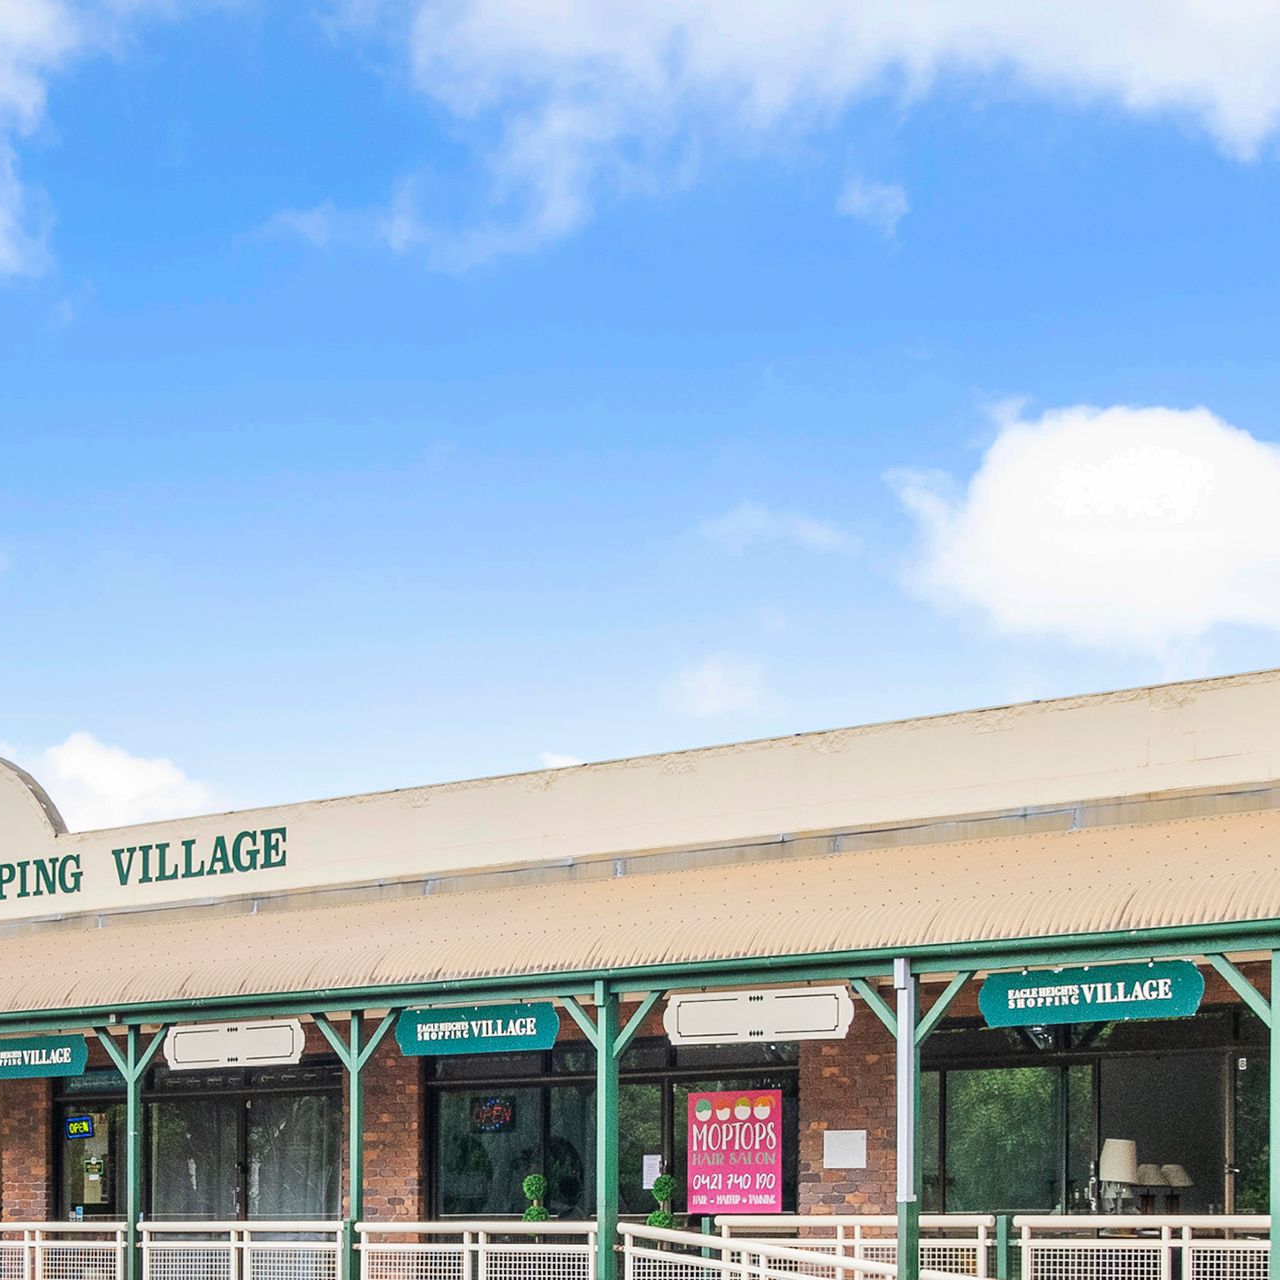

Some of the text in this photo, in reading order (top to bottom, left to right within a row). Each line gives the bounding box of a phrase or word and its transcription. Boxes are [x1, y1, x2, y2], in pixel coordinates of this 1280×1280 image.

[112, 826, 287, 886] VILLAGE
[1008, 985, 1080, 1000] EAGLE HEIGHTS
[1080, 978, 1173, 1004] VILLAGE
[1008, 996, 1080, 1009] SHOPPING
[417, 1030, 470, 1041] SHOPPING
[470, 1017, 537, 1038] VILLAGE
[22, 1047, 72, 1066] VILLAGE
[692, 1121, 777, 1151] MOPTOPS
[692, 1151, 776, 1165] HAIR SALON
[692, 1173, 776, 1190] 0421 740 190
